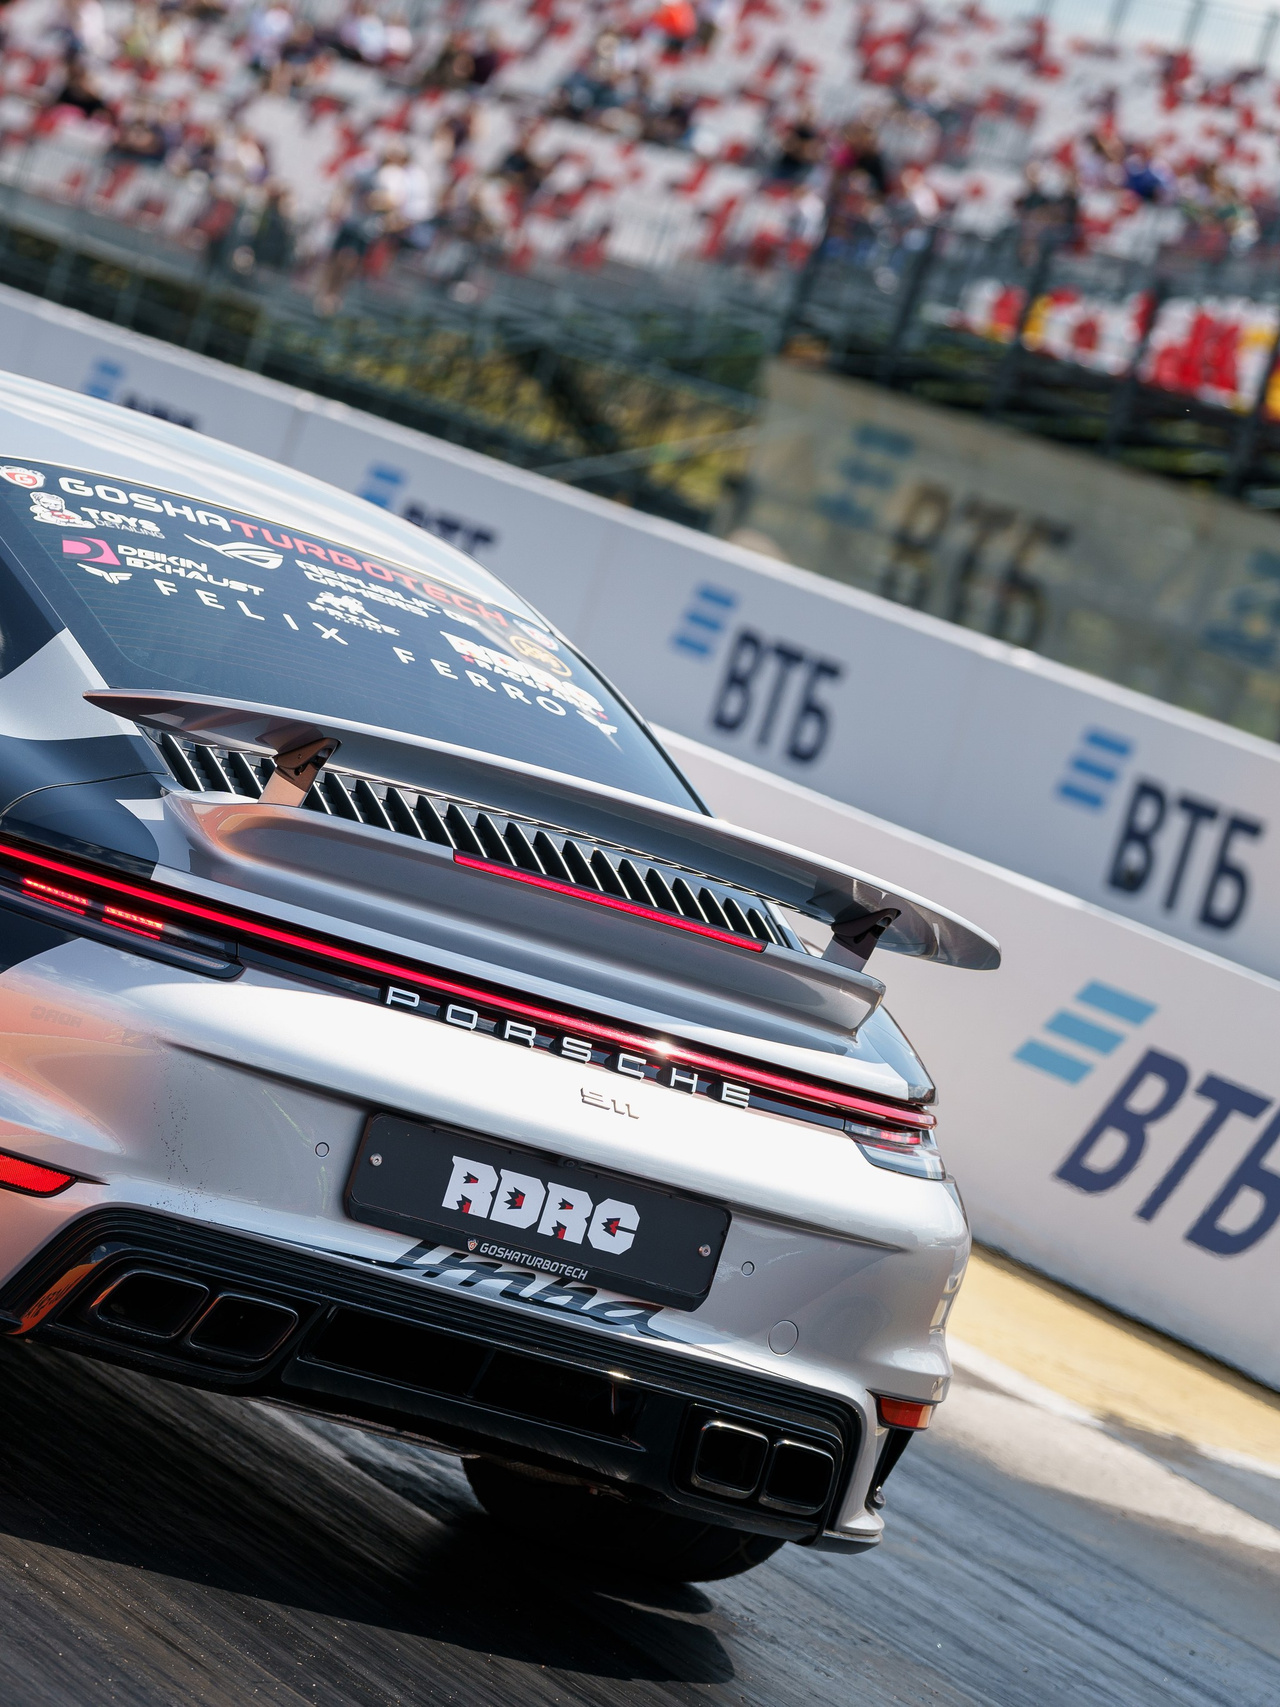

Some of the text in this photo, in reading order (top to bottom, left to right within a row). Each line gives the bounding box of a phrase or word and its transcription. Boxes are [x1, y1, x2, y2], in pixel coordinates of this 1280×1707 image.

[58, 476, 509, 628] GOSHATURBOTECH
[80, 506, 161, 532] TOYS
[93, 518, 165, 539] DETAILING
[126, 556, 265, 596] EXHAUST
[295, 559, 442, 615] REPUBLIC
[304, 570, 429, 618] GAMERS
[153, 578, 349, 646] FELIX
[392, 646, 566, 716] FERRO
[712, 626, 847, 766] ВТБ
[1106, 779, 1266, 932] ВТБ
[386, 985, 752, 1110] PORSCHE
[442, 1155, 641, 1256] RDRC
[479, 1242, 589, 1281] GOSHATURBOTECH
